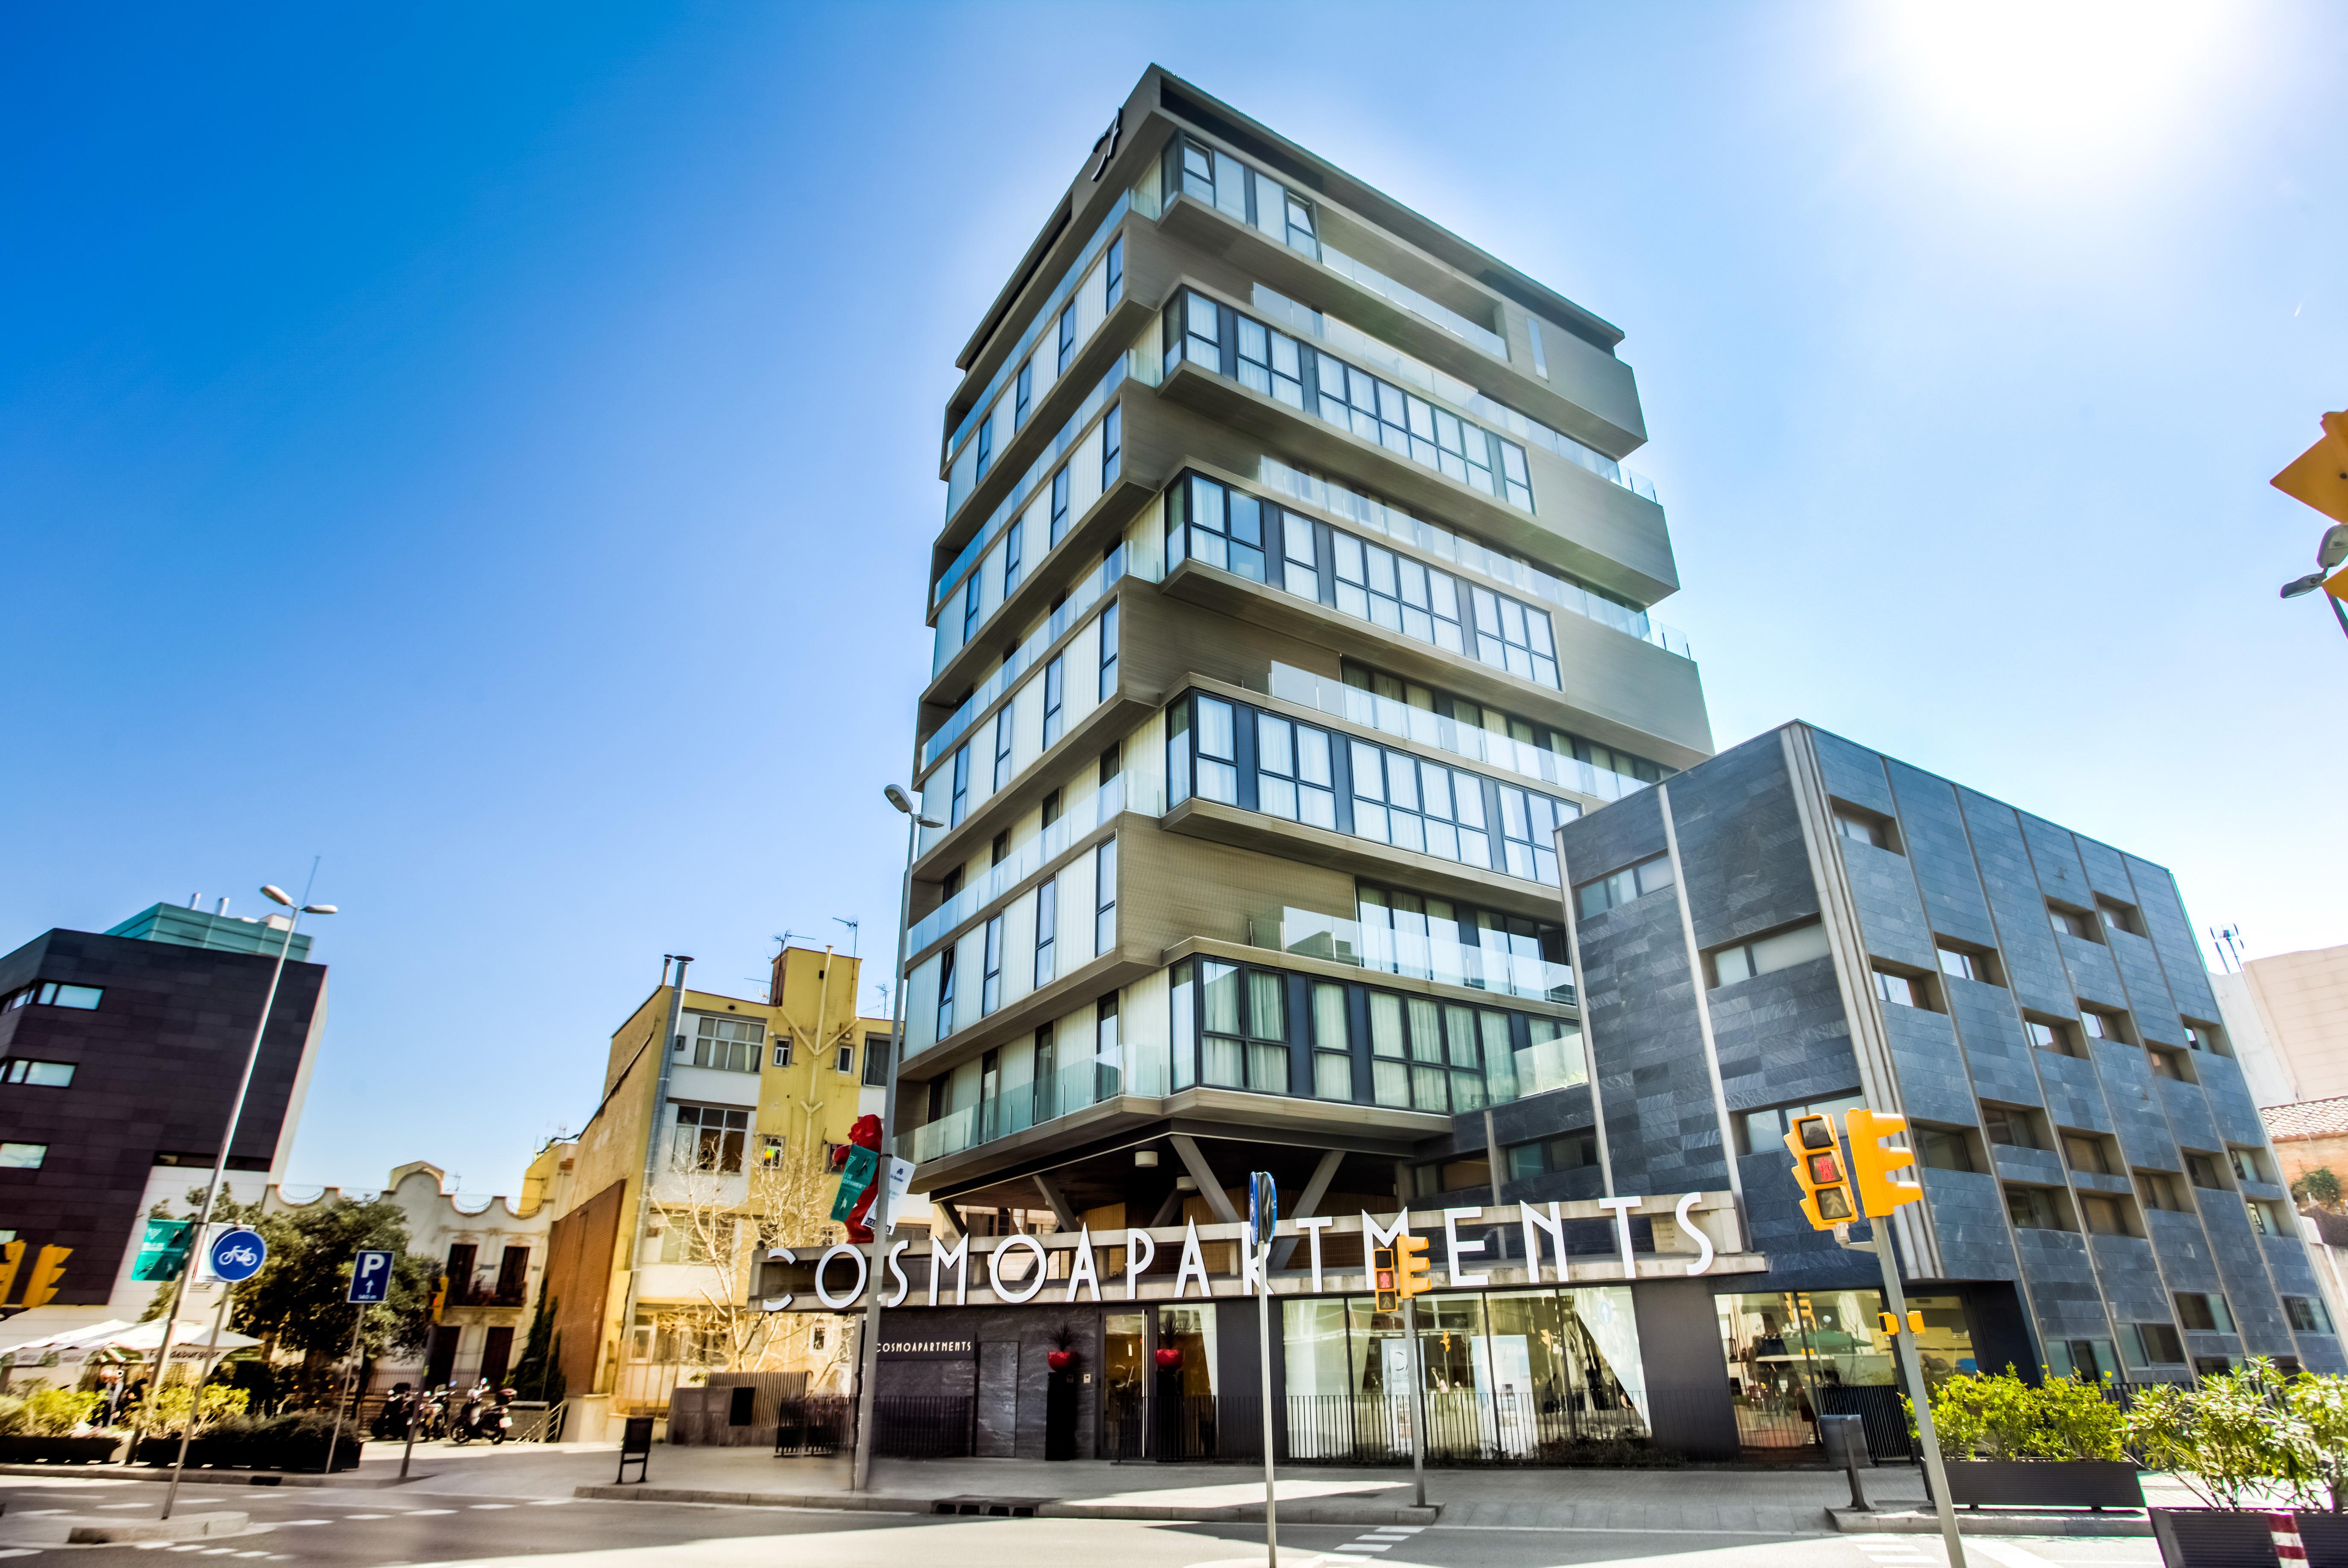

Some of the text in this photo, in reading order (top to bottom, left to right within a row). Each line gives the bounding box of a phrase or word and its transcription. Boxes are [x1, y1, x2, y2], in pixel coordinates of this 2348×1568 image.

[763, 1192, 1714, 1312] COSMOAPARTMENTS
[361, 1254, 385, 1278] P
[876, 1341, 971, 1352] COSMOAPARTMENTS
